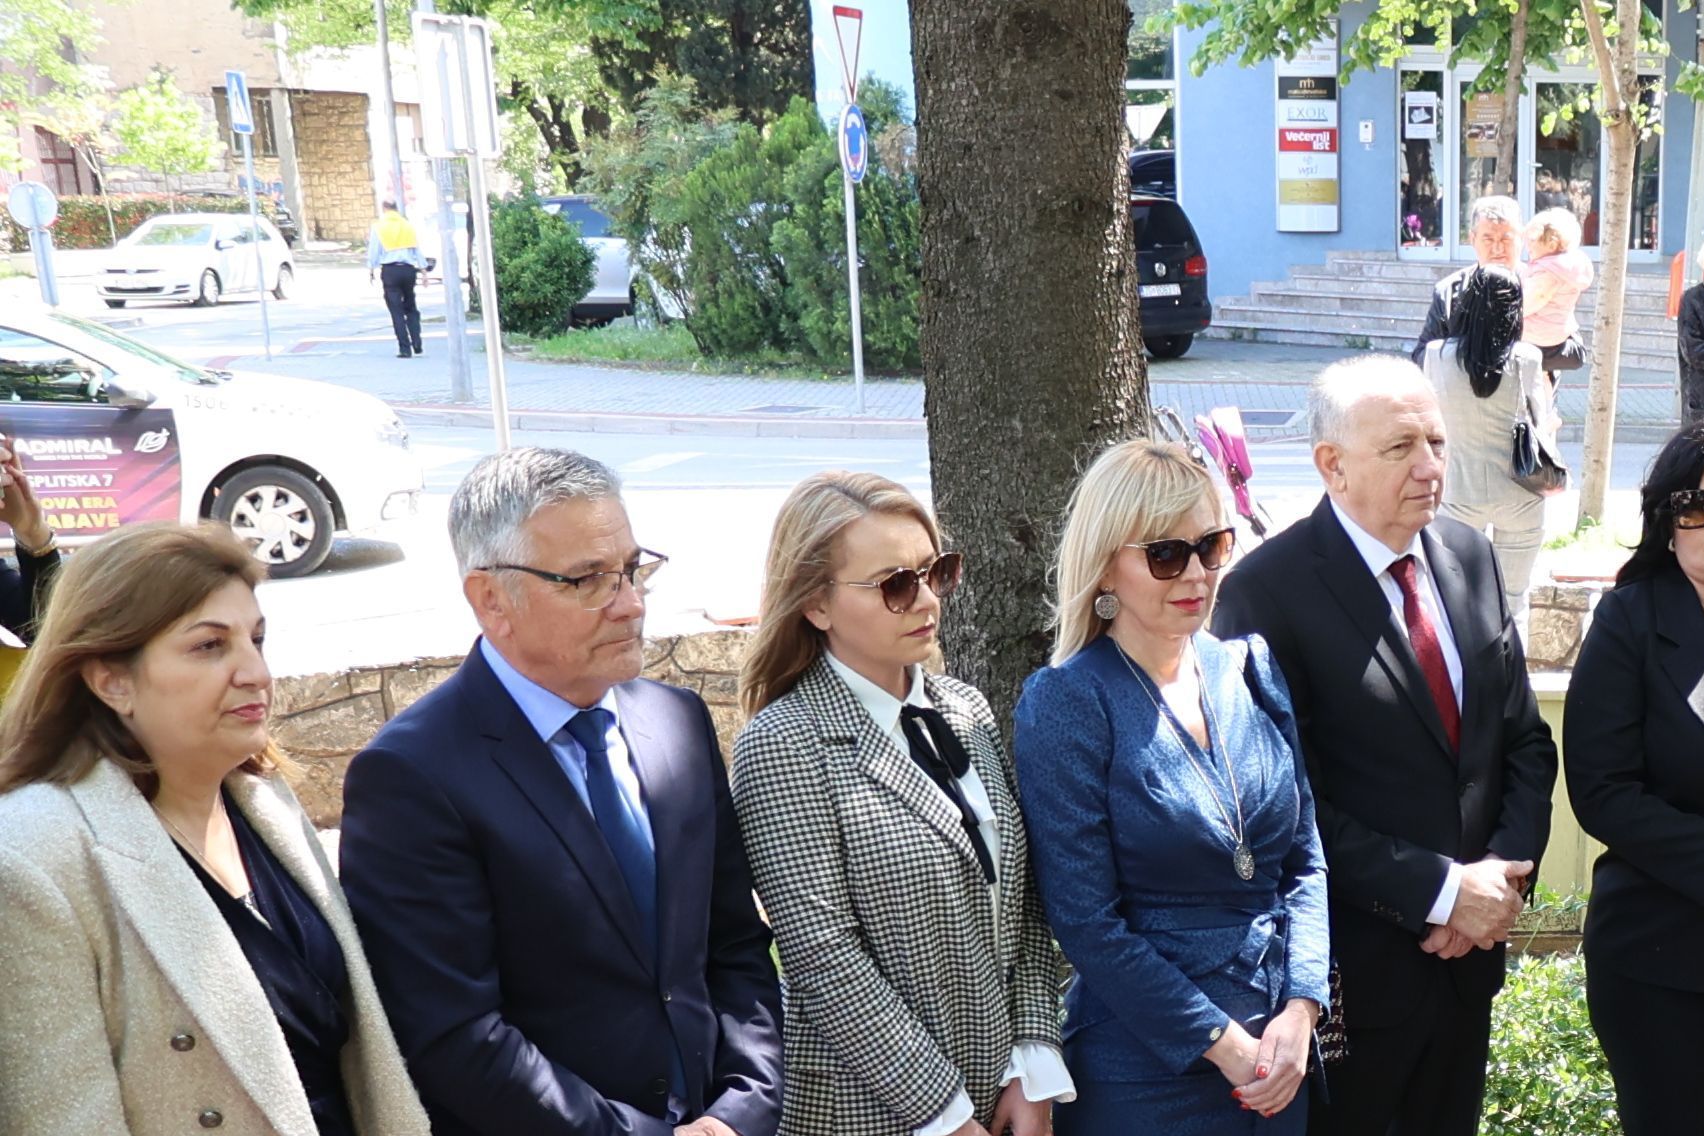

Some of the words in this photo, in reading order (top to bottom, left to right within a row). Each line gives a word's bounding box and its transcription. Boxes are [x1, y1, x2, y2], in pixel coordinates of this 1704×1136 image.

[1287, 107, 1328, 119] EXOR
[1285, 131, 1331, 142] Večernji
[1313, 140, 1331, 150] list
[14, 437, 122, 455] ADMIRAL
[28, 474, 101, 488] SPLITSKA
[103, 474, 114, 487] 7
[41, 496, 79, 510] OVA
[82, 496, 118, 509] ERA
[46, 512, 120, 528] ABAVE
